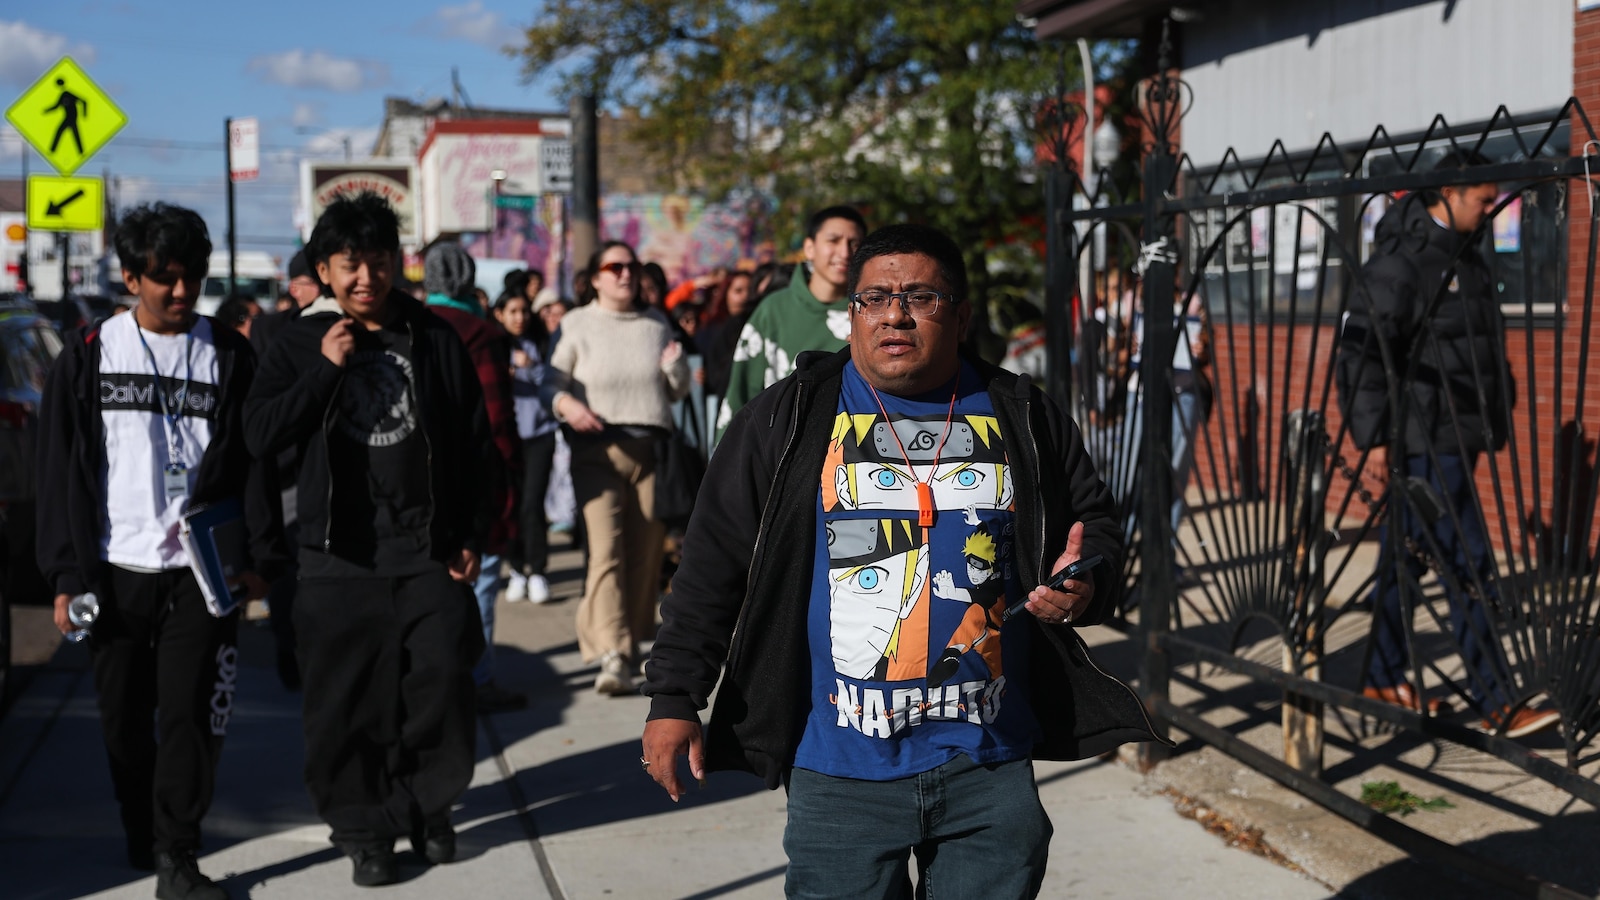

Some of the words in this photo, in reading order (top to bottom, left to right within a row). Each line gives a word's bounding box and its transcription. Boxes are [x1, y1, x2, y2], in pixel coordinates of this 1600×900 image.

[542, 146, 572, 158] ONE
[542, 160, 573, 171] WAY
[100, 380, 167, 404] Calvi
[835, 675, 1007, 739] NARUTO
